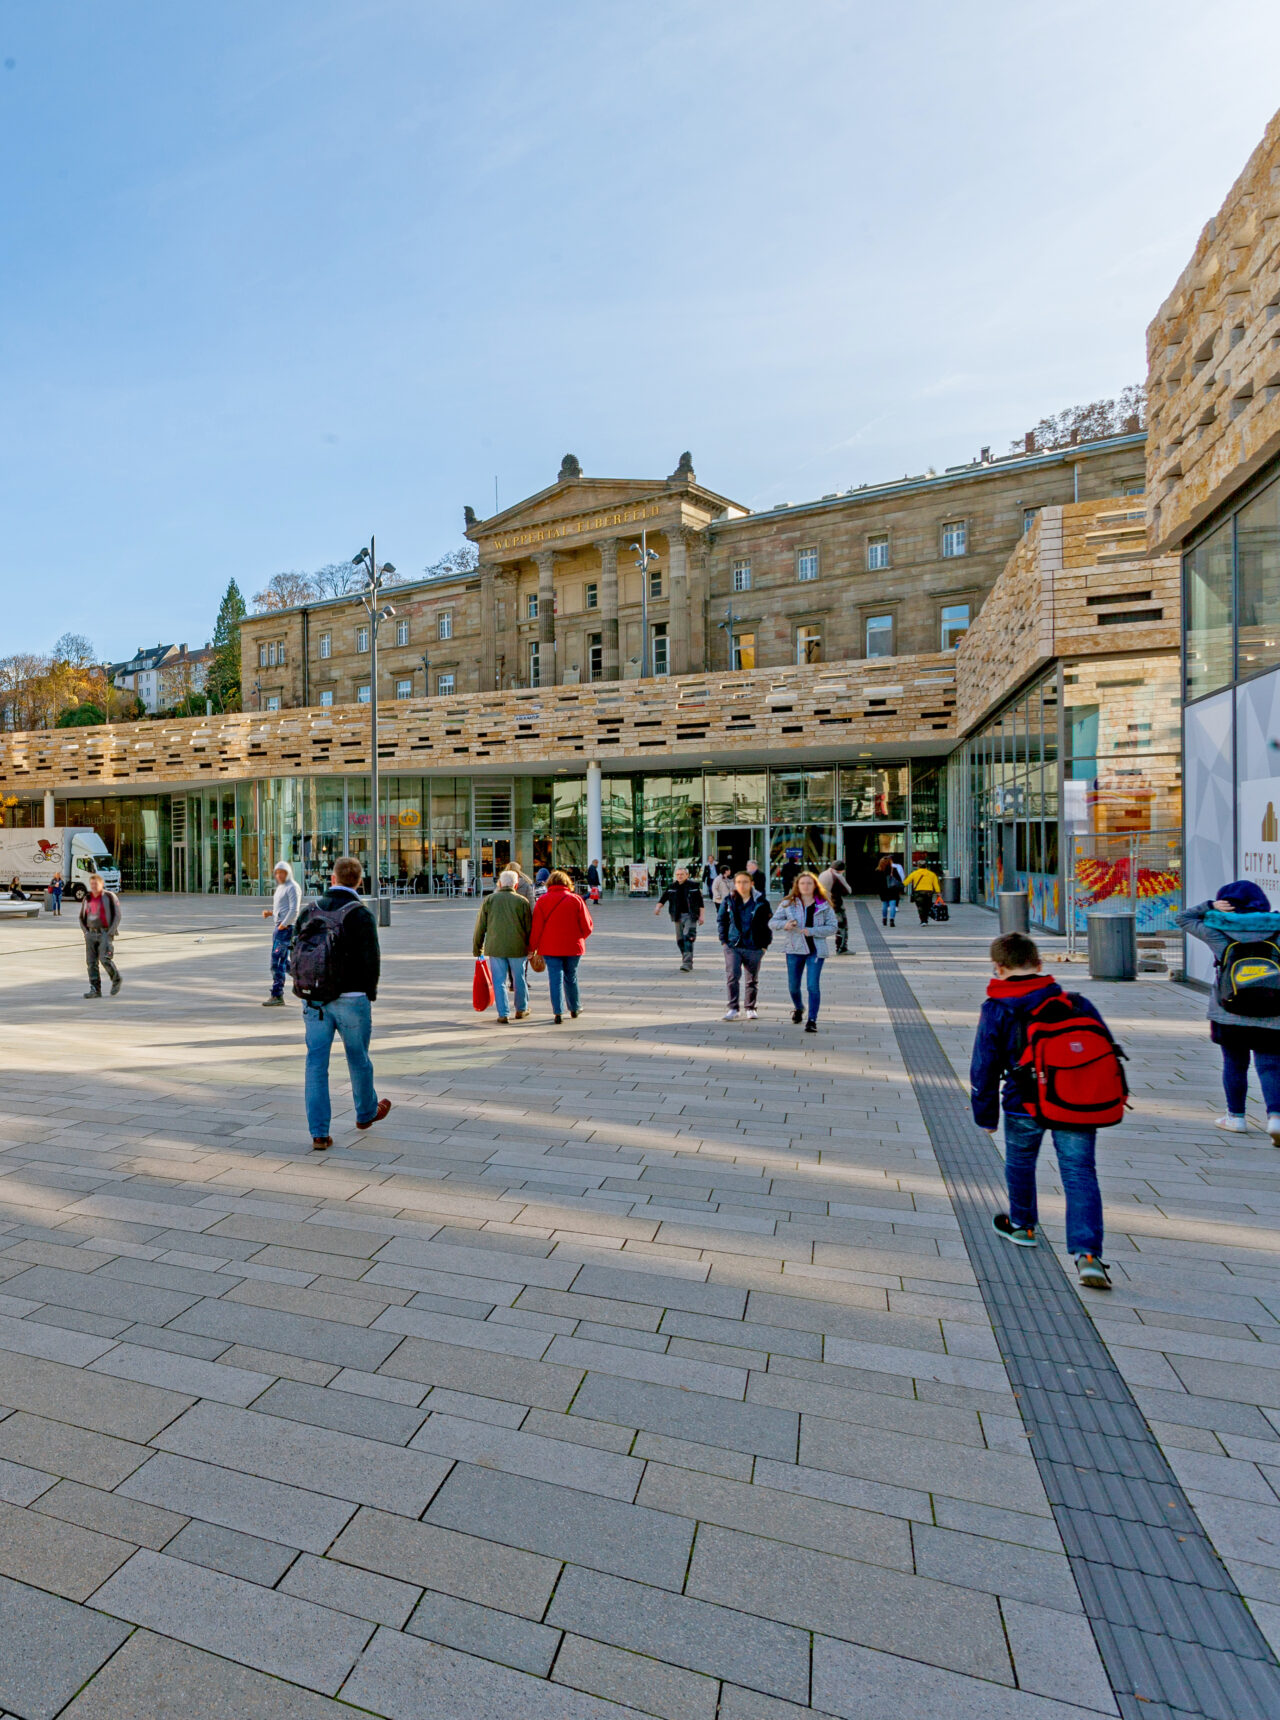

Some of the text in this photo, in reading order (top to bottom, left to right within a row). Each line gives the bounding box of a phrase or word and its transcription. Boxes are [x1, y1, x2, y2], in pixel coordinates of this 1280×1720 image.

[494, 505, 660, 550] WUPPERTAL ELBERFELD
[1245, 852, 1280, 874] CITY PL
[1242, 966, 1268, 975] NIKE
